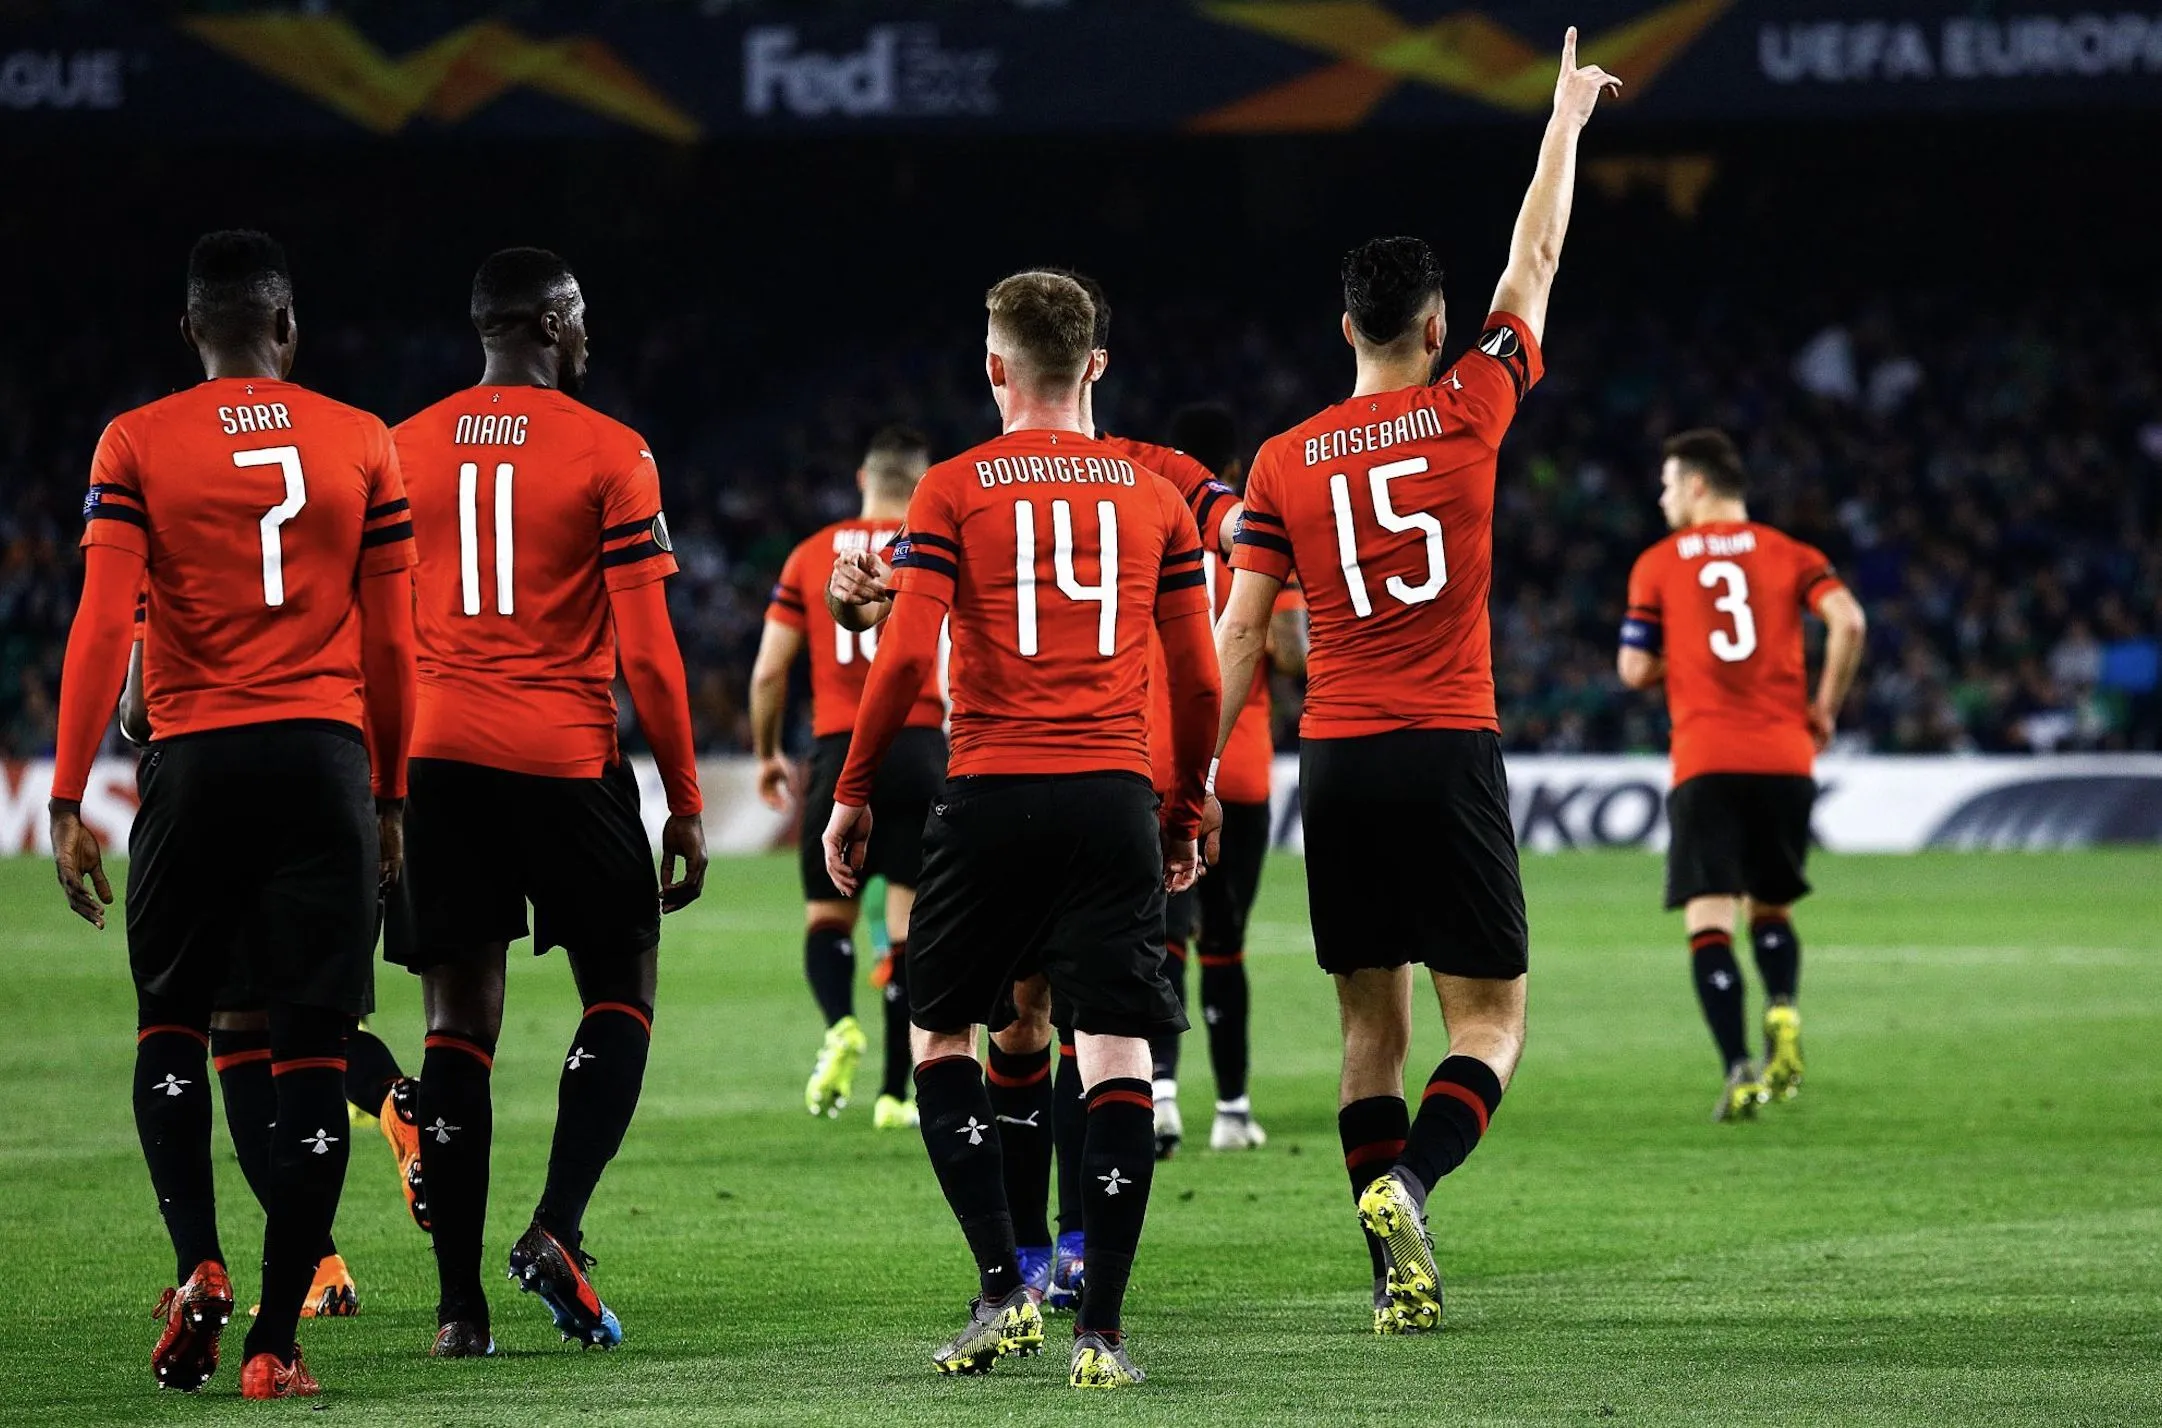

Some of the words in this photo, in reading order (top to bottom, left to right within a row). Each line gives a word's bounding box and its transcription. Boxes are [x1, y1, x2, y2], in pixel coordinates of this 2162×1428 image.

[1758, 20, 1938, 82] UEFA
[218, 402, 292, 434] SARR
[454, 413, 529, 446] NIANG
[1304, 405, 1443, 467] BENSEBAINI
[975, 456, 1136, 488] BOURIGEAUD
[232, 445, 307, 607] 7
[458, 462, 514, 616] 11
[1329, 456, 1448, 618] 15
[1014, 498, 1119, 657] 14
[1698, 560, 1757, 662] 3
